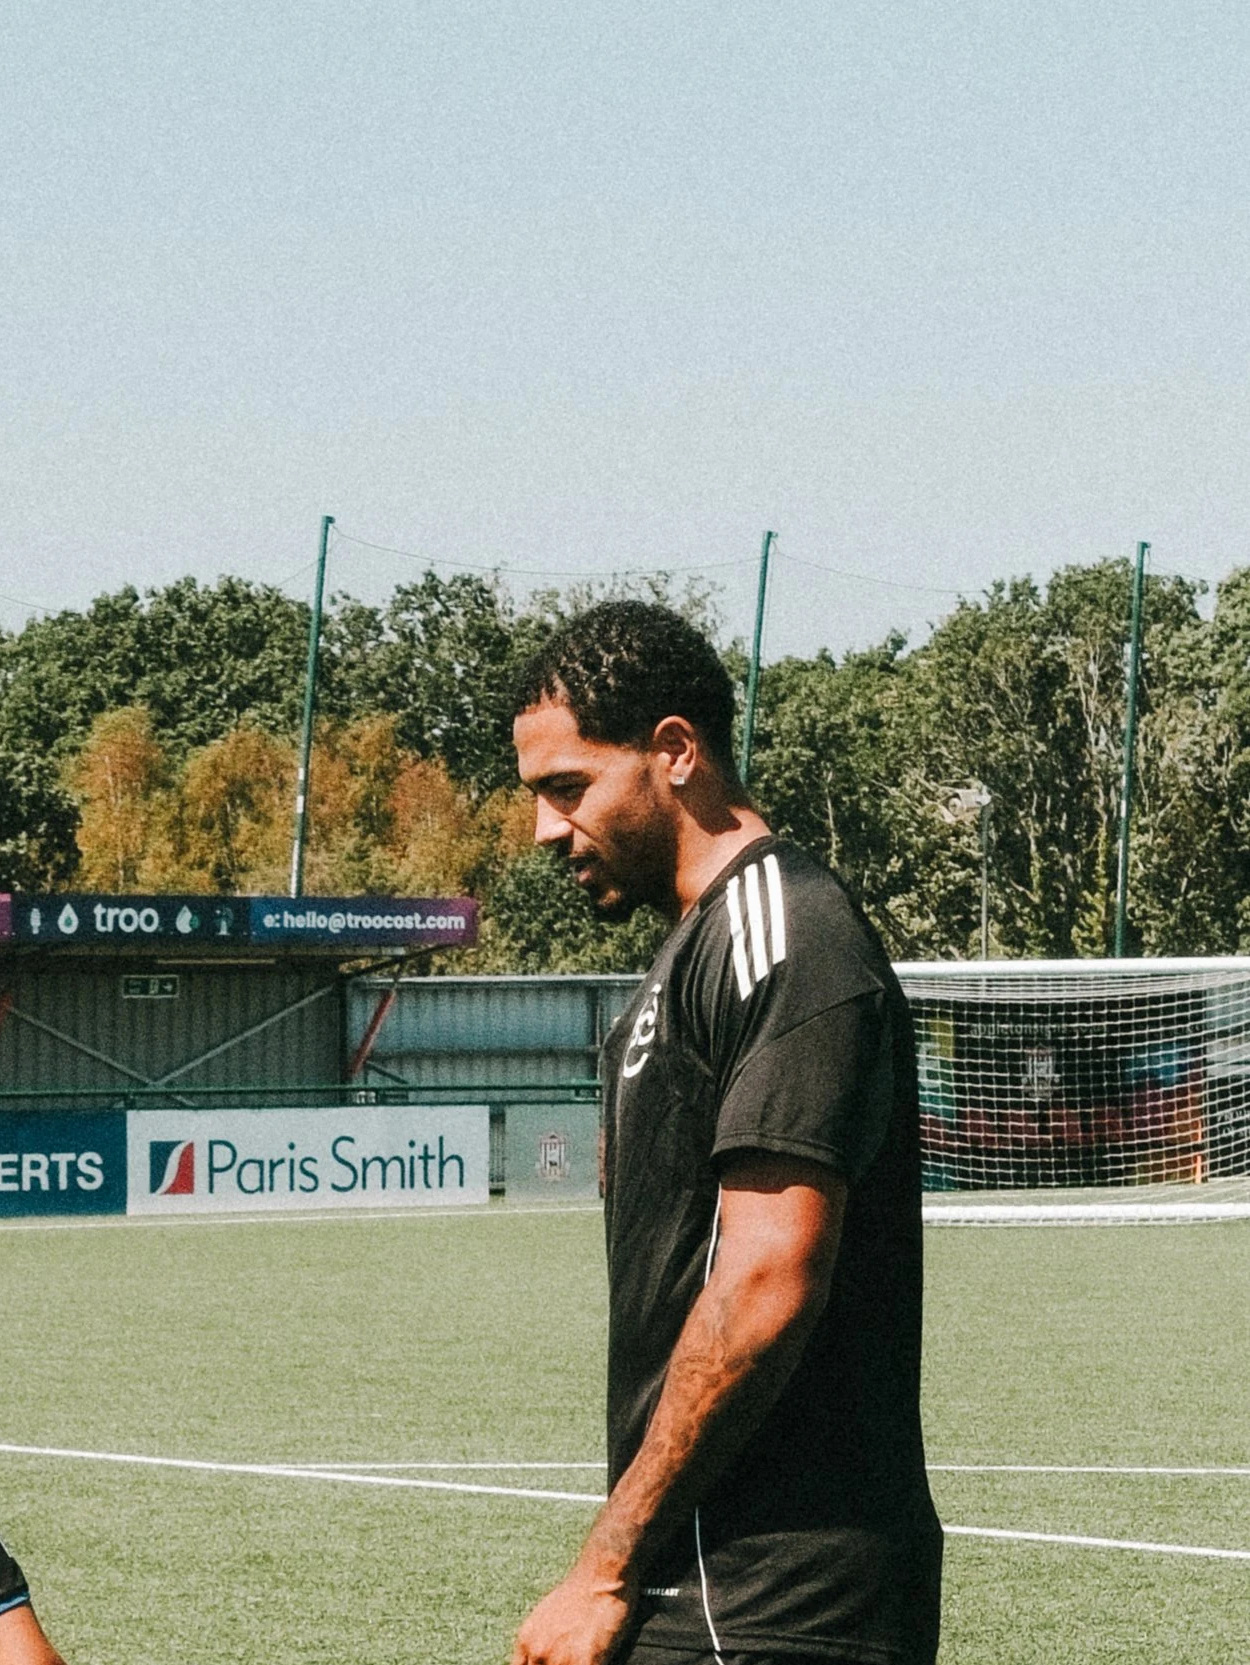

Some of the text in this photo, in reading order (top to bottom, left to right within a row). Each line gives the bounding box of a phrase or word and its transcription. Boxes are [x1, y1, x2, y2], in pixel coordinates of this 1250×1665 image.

[263, 911, 466, 934] e: hello@troocost.com
[207, 1135, 464, 1194] Paris Smith
